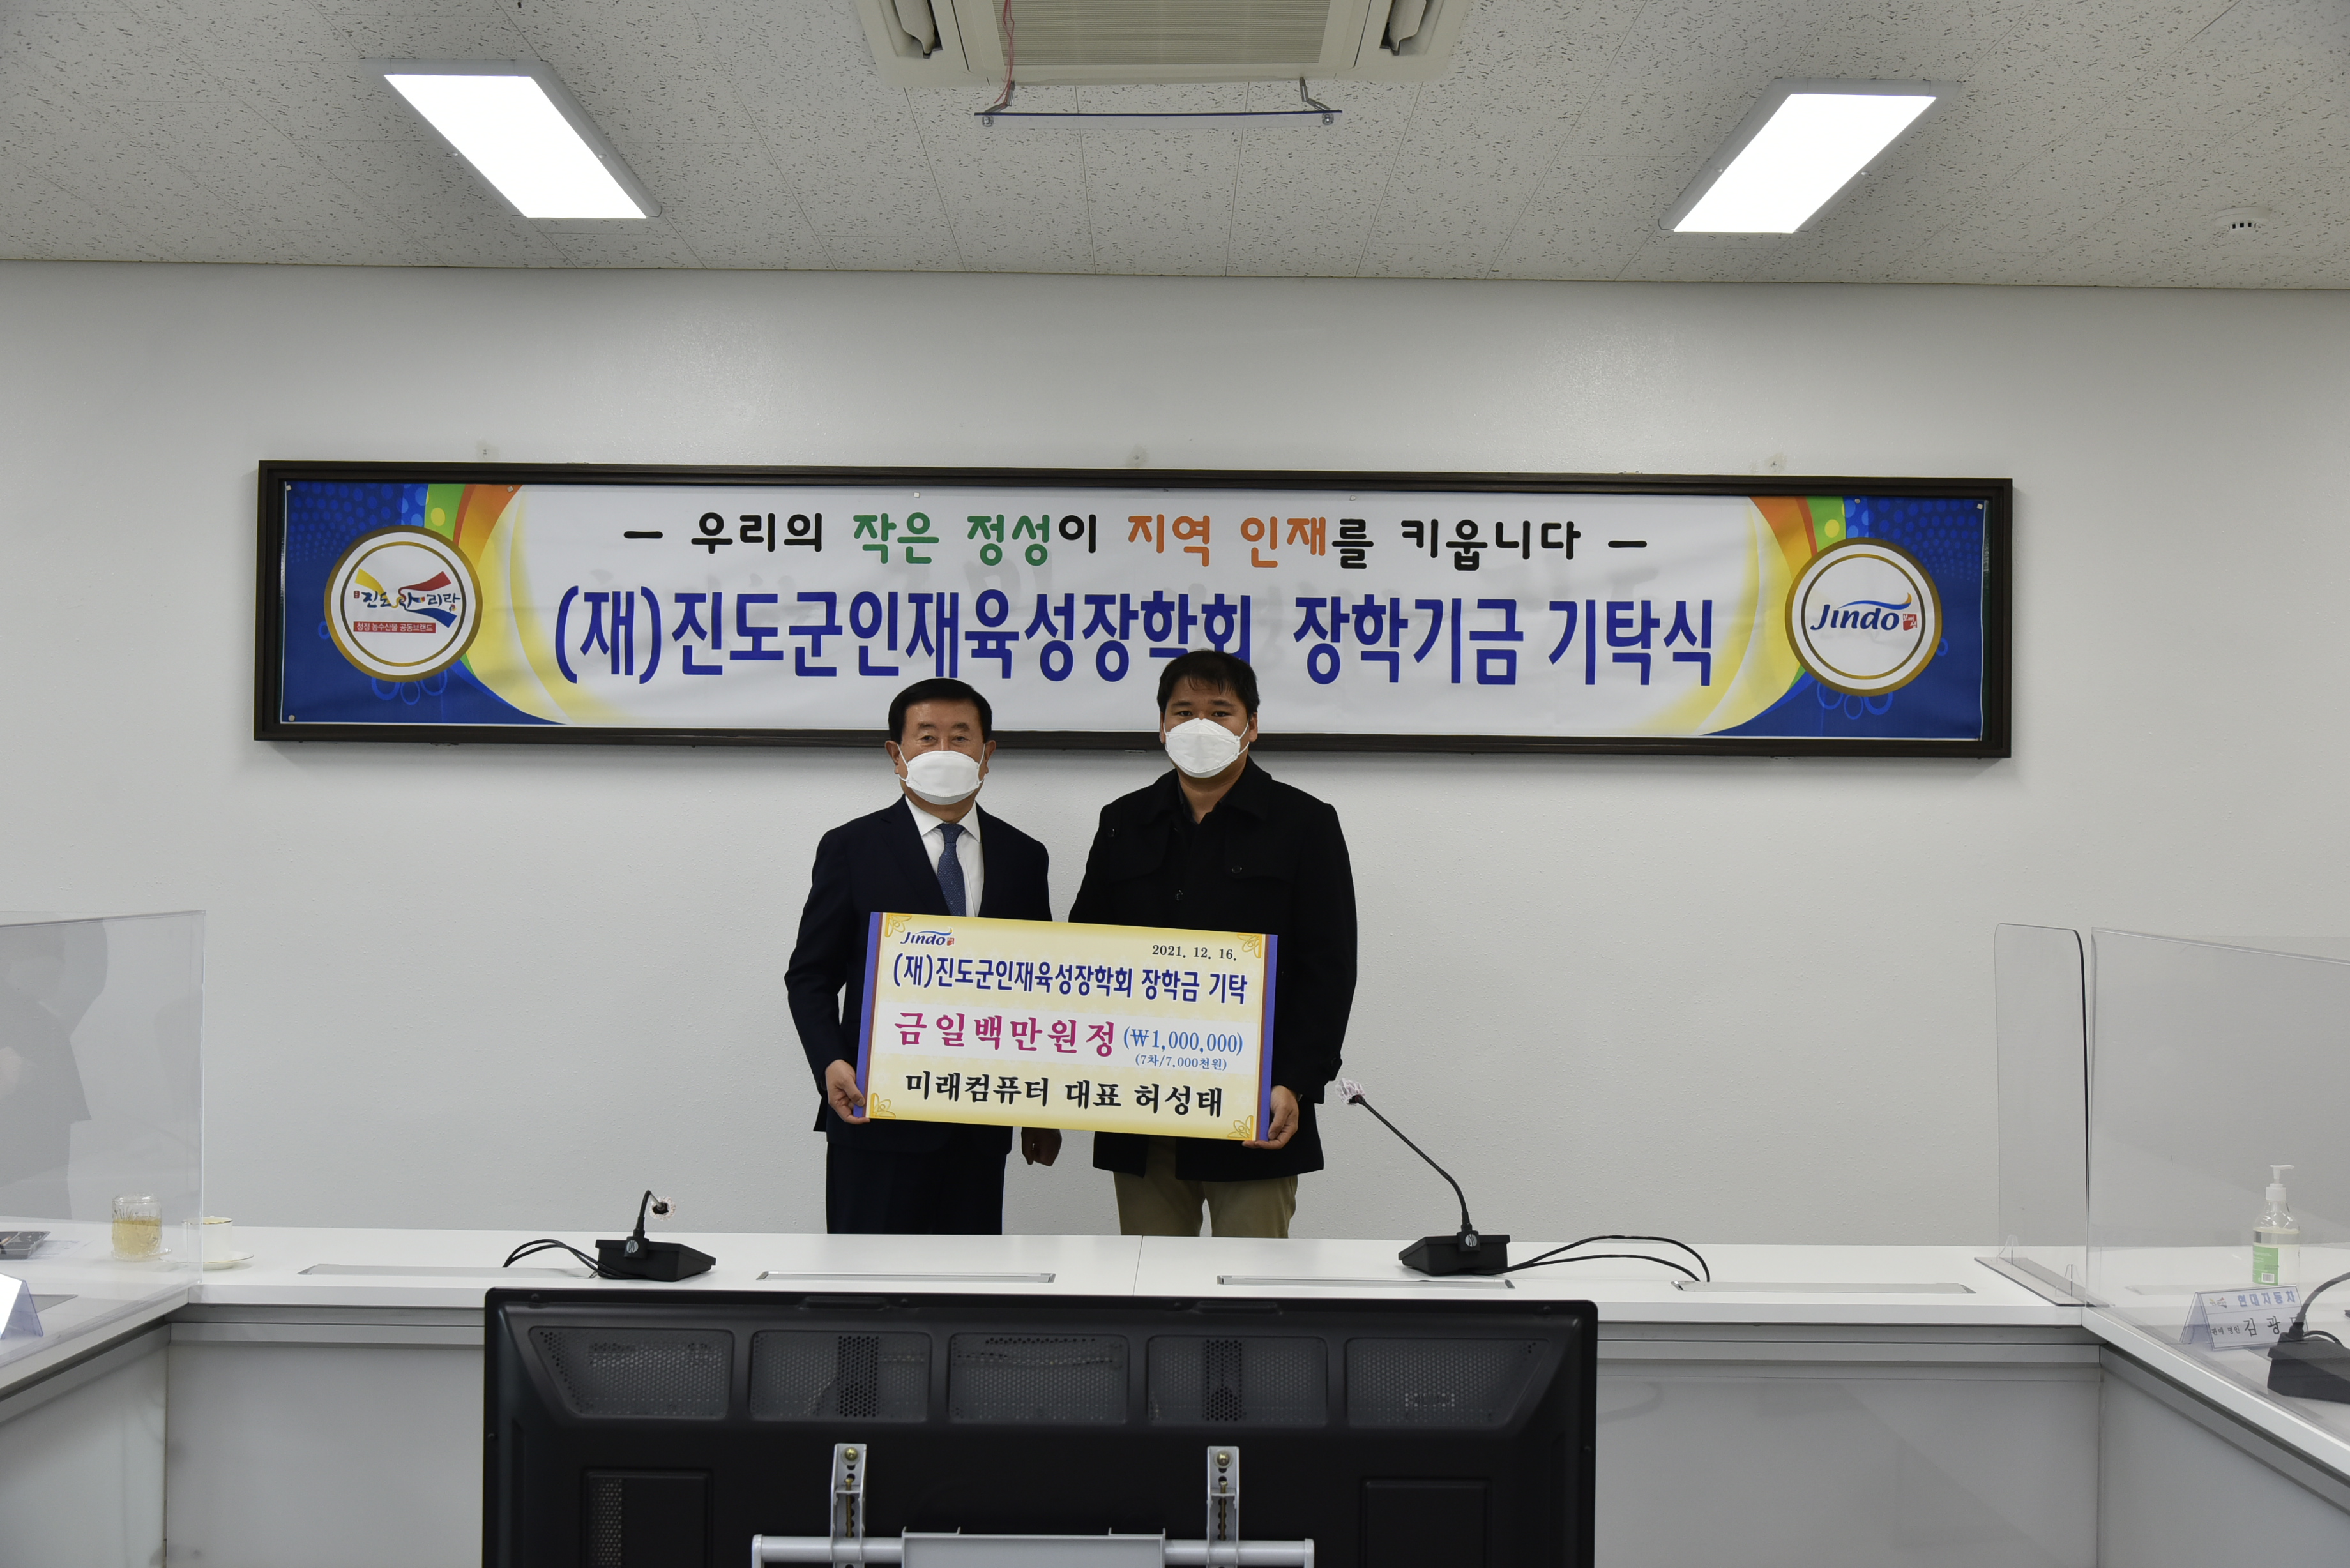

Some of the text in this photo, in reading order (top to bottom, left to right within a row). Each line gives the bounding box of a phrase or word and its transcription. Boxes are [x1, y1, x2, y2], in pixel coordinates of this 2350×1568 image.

[691, 511, 822, 554] 우리의
[853, 511, 939, 564] 작은
[967, 513, 1097, 566] 정성이
[1127, 513, 1211, 567] 지역
[1239, 515, 1374, 569] 인재를
[1400, 518, 1582, 571] 키웁니다
[356, 622, 434, 632] 청정 농수산물 공동브랜드
[1810, 604, 1900, 631] Jindo
[1293, 593, 1524, 686] 장학기금
[1548, 598, 1713, 687] 기탁식
[900, 931, 946, 946] Jindo
[1152, 944, 1237, 961] 2021. 12. 16.
[893, 952, 1248, 1005] (재)진도군인재육성장학회 장학금 기탁
[1123, 1025, 1243, 1057] (₩1,000,000)
[1135, 1053, 1227, 1071] (7차/7,000천원)
[906, 1071, 1223, 1118] 미래컴퓨터 대표 허성태
[2237, 1290, 2296, 1308] 현대자동차
